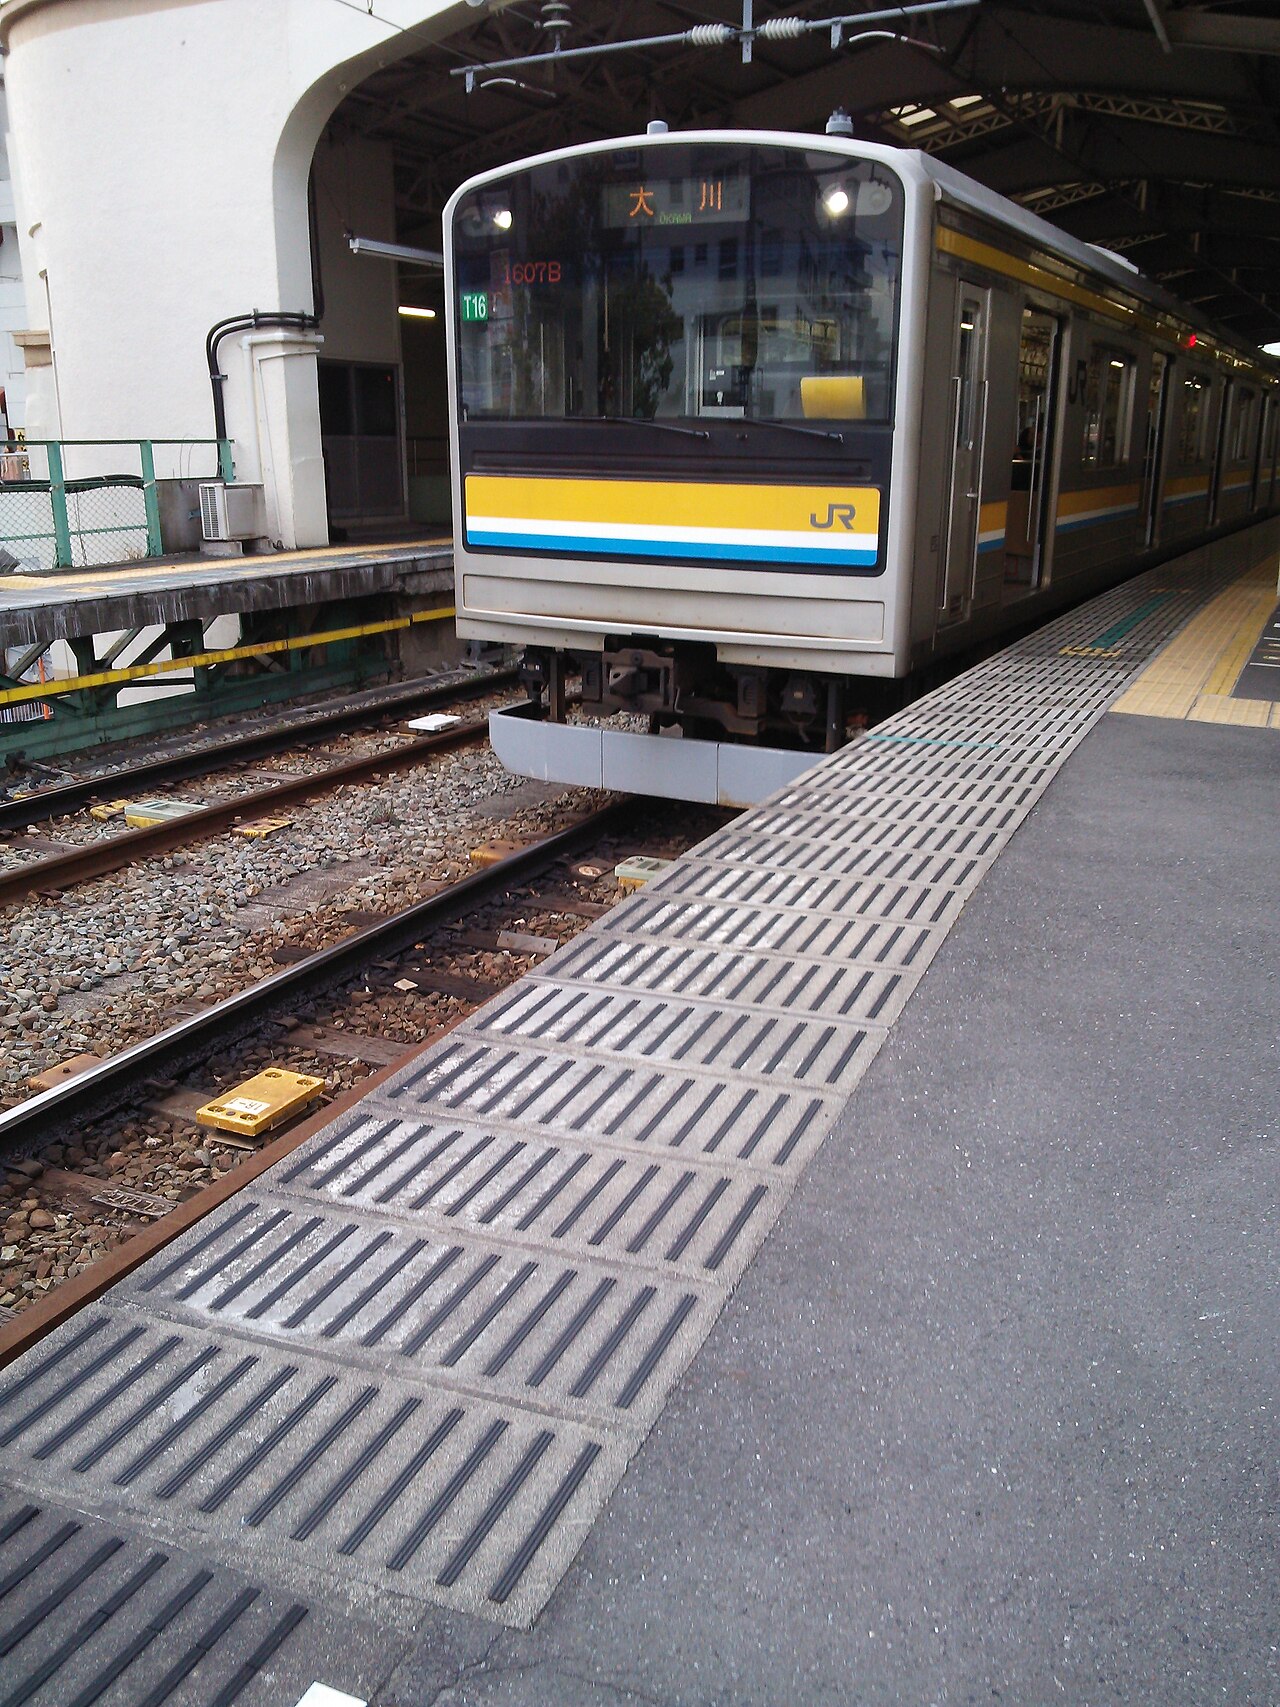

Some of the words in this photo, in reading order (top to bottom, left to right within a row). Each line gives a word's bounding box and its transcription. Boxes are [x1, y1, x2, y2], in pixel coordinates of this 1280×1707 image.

[504, 261, 561, 285] 1607B
[463, 295, 487, 319] T16
[810, 503, 856, 530] JR
